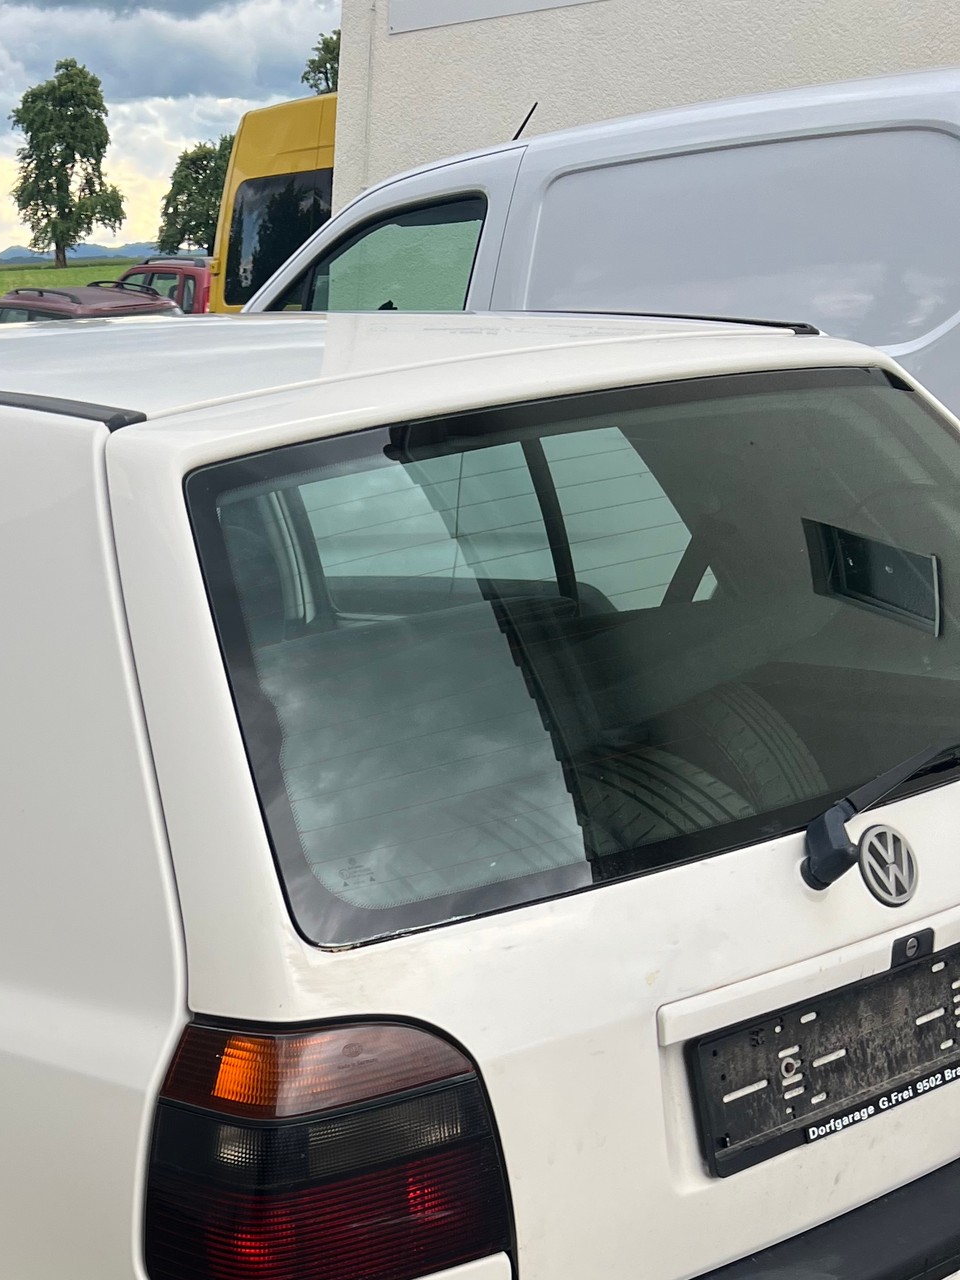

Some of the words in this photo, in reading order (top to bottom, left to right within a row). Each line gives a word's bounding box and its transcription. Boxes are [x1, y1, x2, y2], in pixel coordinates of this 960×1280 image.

[808, 1104, 875, 1140] Dorfgarage
[878, 1086, 914, 1110] G.Frei
[916, 1074, 943, 1093] 9502
